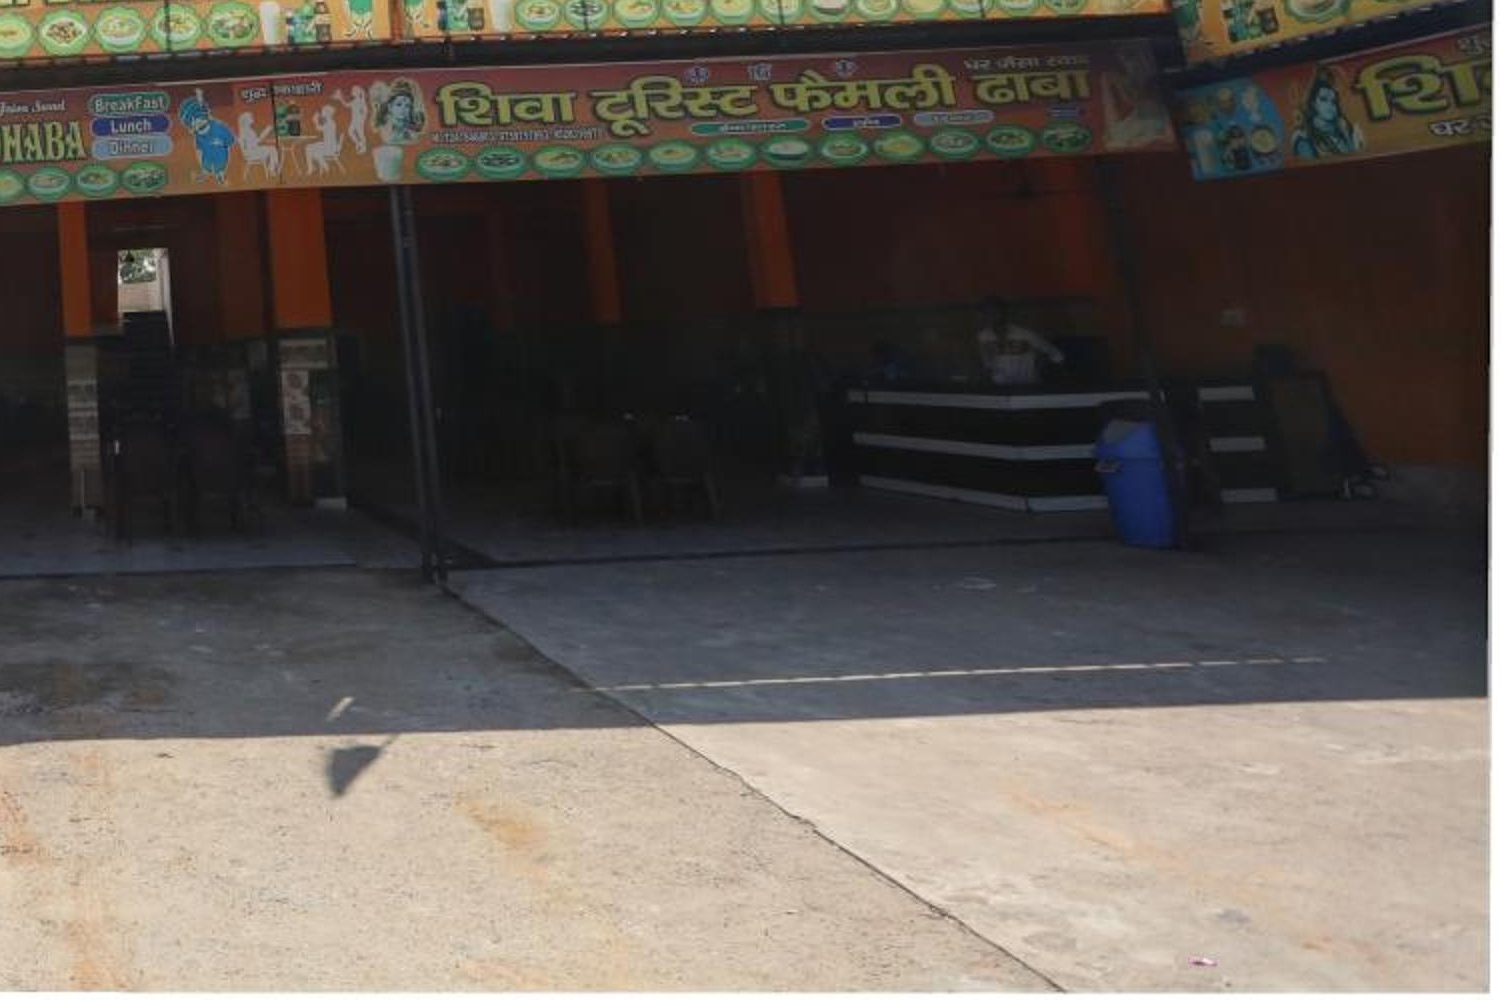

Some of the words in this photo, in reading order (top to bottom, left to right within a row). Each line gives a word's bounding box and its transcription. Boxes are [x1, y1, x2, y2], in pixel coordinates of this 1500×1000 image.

[93, 95, 166, 112] BreakFast
[437, 82, 577, 126] शिवा
[590, 75, 758, 137] टूरिस्ट
[974, 71, 1091, 104] ढाबा
[110, 117, 153, 134] Lunch
[108, 138, 155, 155] Dinner
